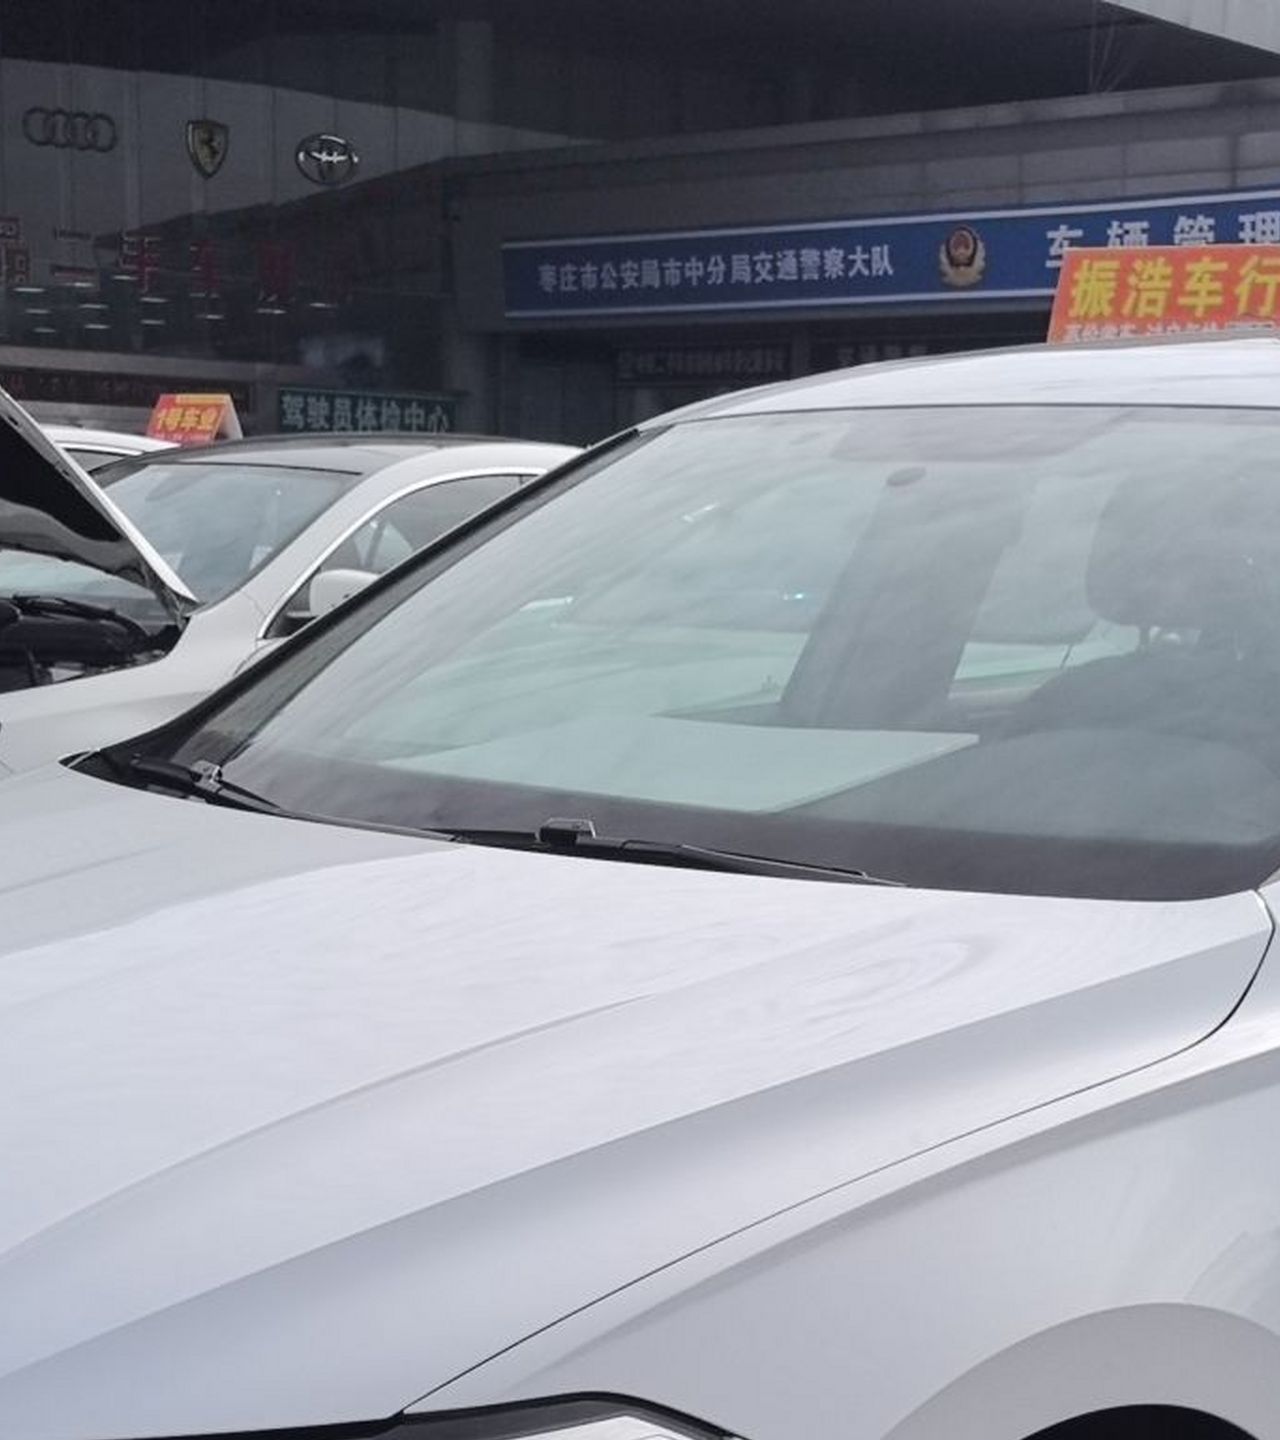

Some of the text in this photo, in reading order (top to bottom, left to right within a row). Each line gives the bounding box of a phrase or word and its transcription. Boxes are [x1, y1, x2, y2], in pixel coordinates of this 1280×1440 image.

[538, 244, 894, 293] 枣庄市公安局市中分局交通警察大队
[280, 393, 449, 433] 驾驶员体检中心
